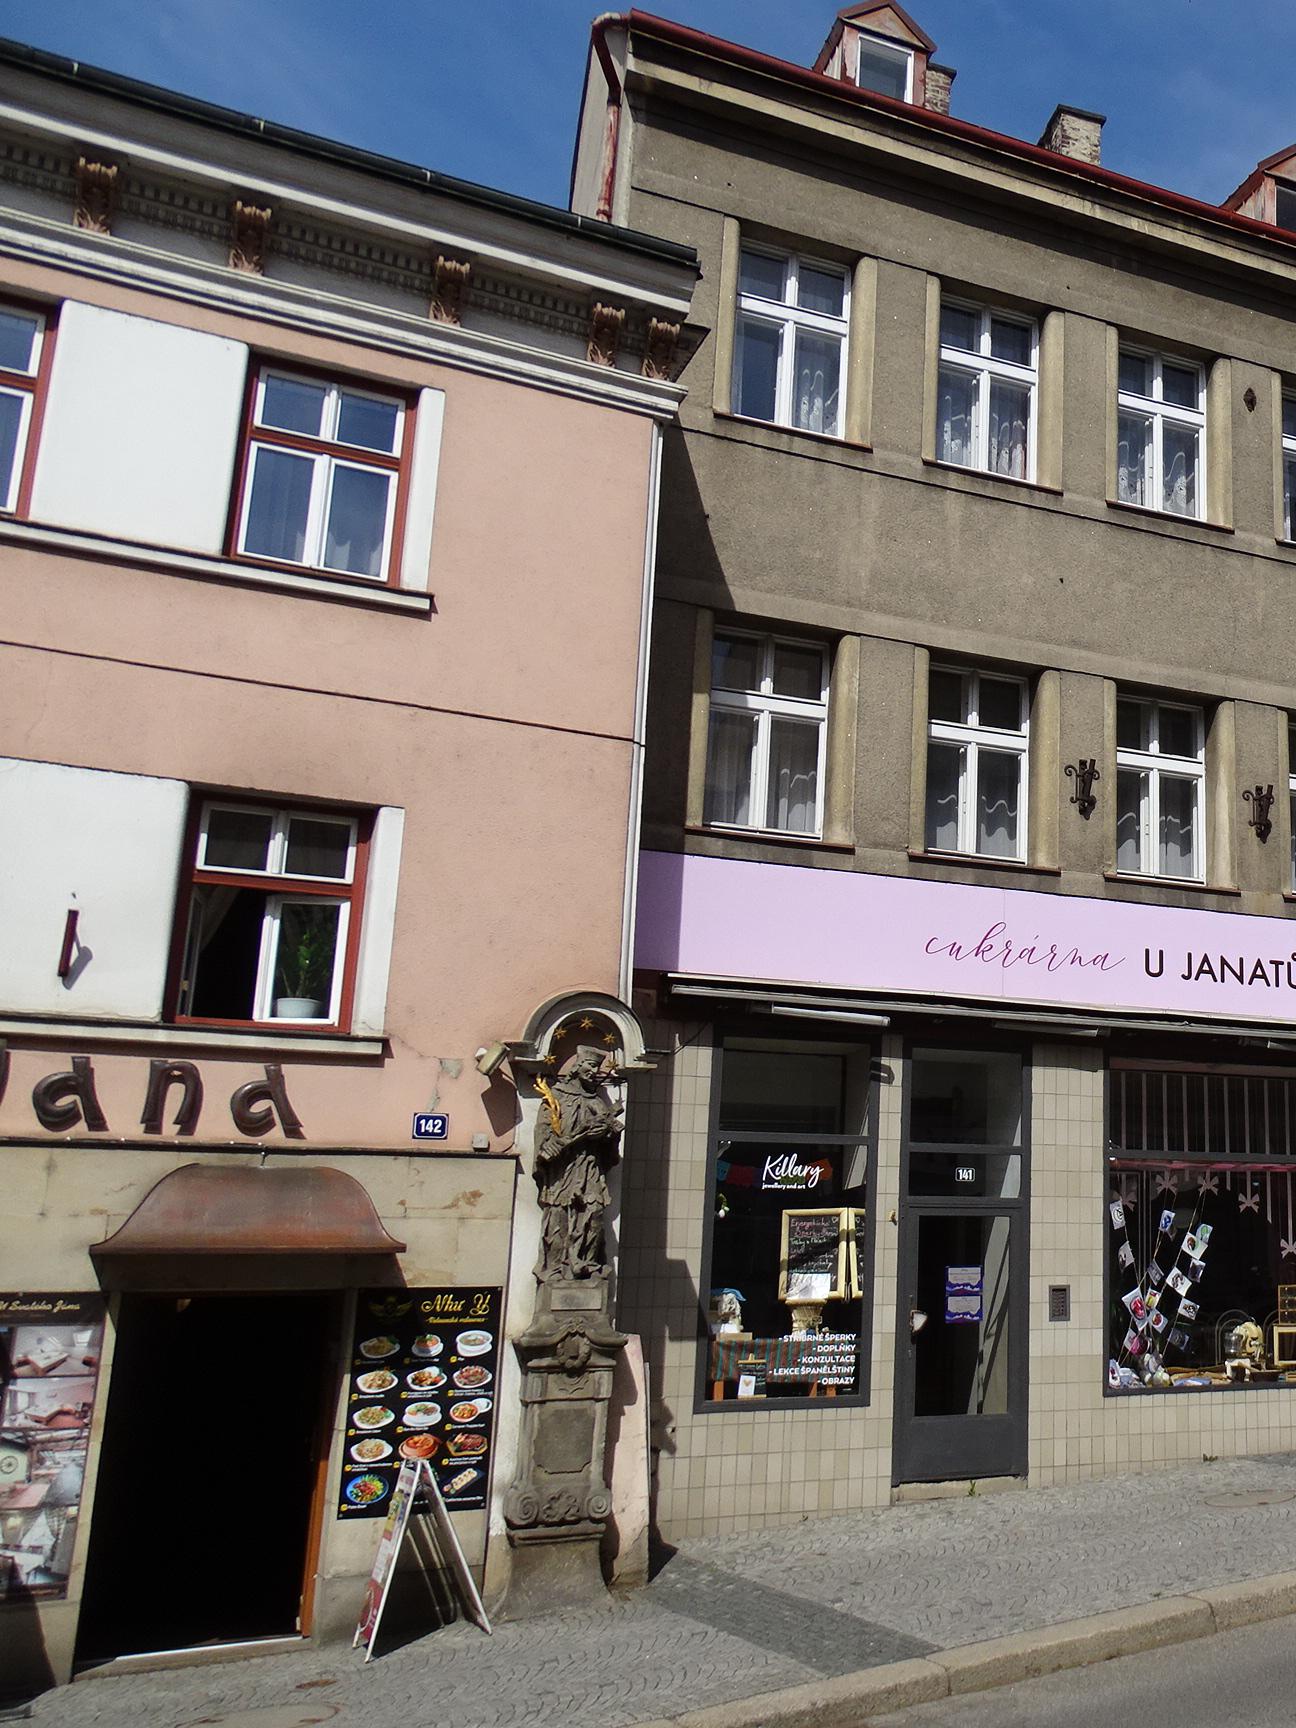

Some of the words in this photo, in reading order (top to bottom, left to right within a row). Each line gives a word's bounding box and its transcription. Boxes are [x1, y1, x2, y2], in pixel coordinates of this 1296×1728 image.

[925, 921, 1125, 972] cukrárna
[1144, 948, 1164, 978] U
[0, 1050, 307, 1139] ana
[420, 1119, 442, 1133] 142
[762, 1153, 825, 1188] Killary
[958, 1169, 973, 1180] 141
[762, 1182, 786, 1190] jewellery
[825, 1333, 857, 1341] ŠPERKY
[817, 1343, 856, 1352] DOPLŇKY
[802, 1355, 856, 1363] KONZULTACE
[773, 1367, 800, 1375] LEKCE
[801, 1365, 855, 1374] ŠPANĚLŠTINY
[822, 1377, 855, 1385] OBRAZY
